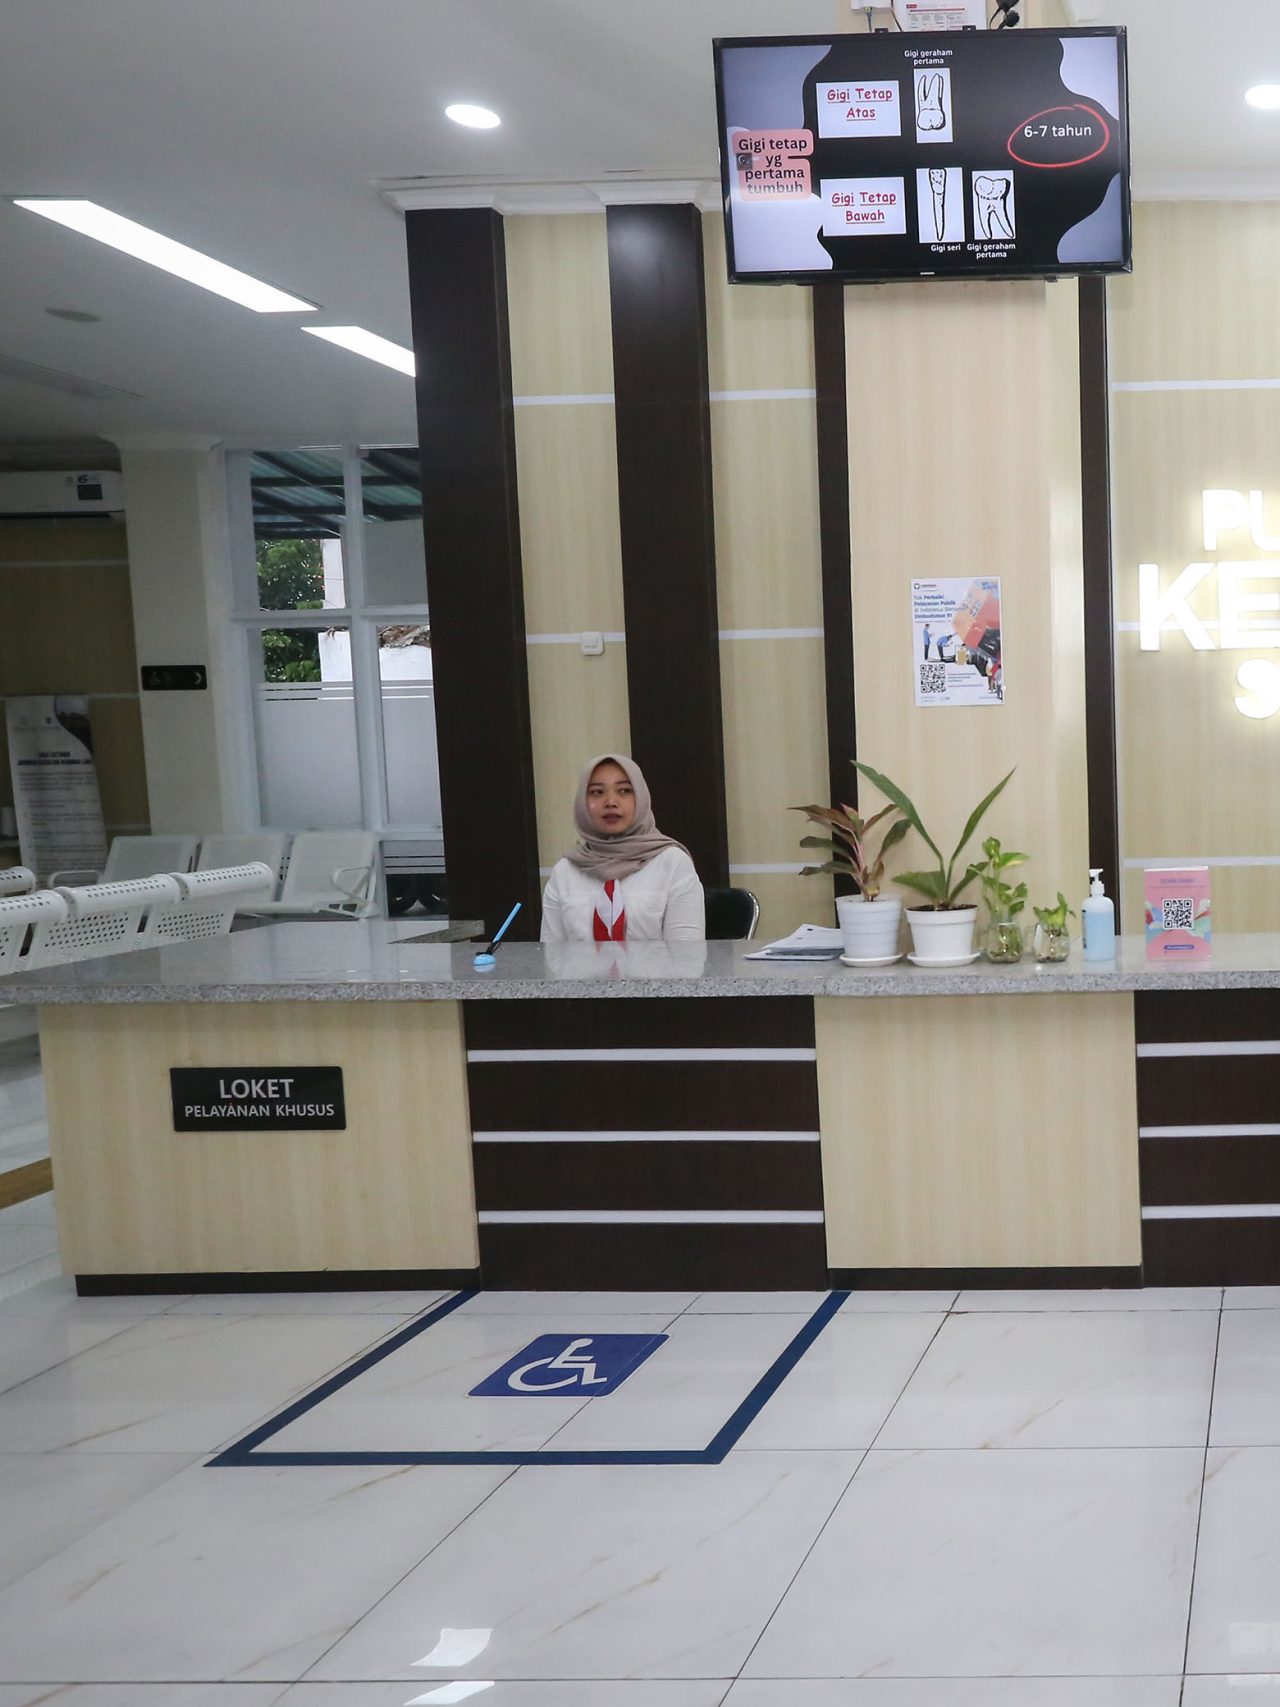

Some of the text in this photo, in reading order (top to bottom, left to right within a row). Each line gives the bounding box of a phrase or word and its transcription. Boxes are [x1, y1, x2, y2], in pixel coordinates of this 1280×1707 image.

[904, 49, 953, 58] Gigi geraham
[913, 58, 944, 66] pertama
[827, 88, 893, 103] Gigi Tetap
[846, 107, 876, 118] Atas
[1023, 124, 1092, 137] 6-7 tahun
[738, 138, 807, 153] Gigi tetap
[765, 155, 782, 167] yg
[745, 168, 804, 182] pertama
[747, 181, 803, 194] tumbuh
[832, 192, 897, 206] Gigi Tetap
[846, 209, 885, 221] Bawah
[931, 244, 946, 253] Gigi
[967, 243, 1016, 252] Gigi geraham
[976, 252, 1007, 260] pertama
[219, 1078, 294, 1099] LOKET
[184, 1103, 335, 1118] PELAYANAN KHUSUS
